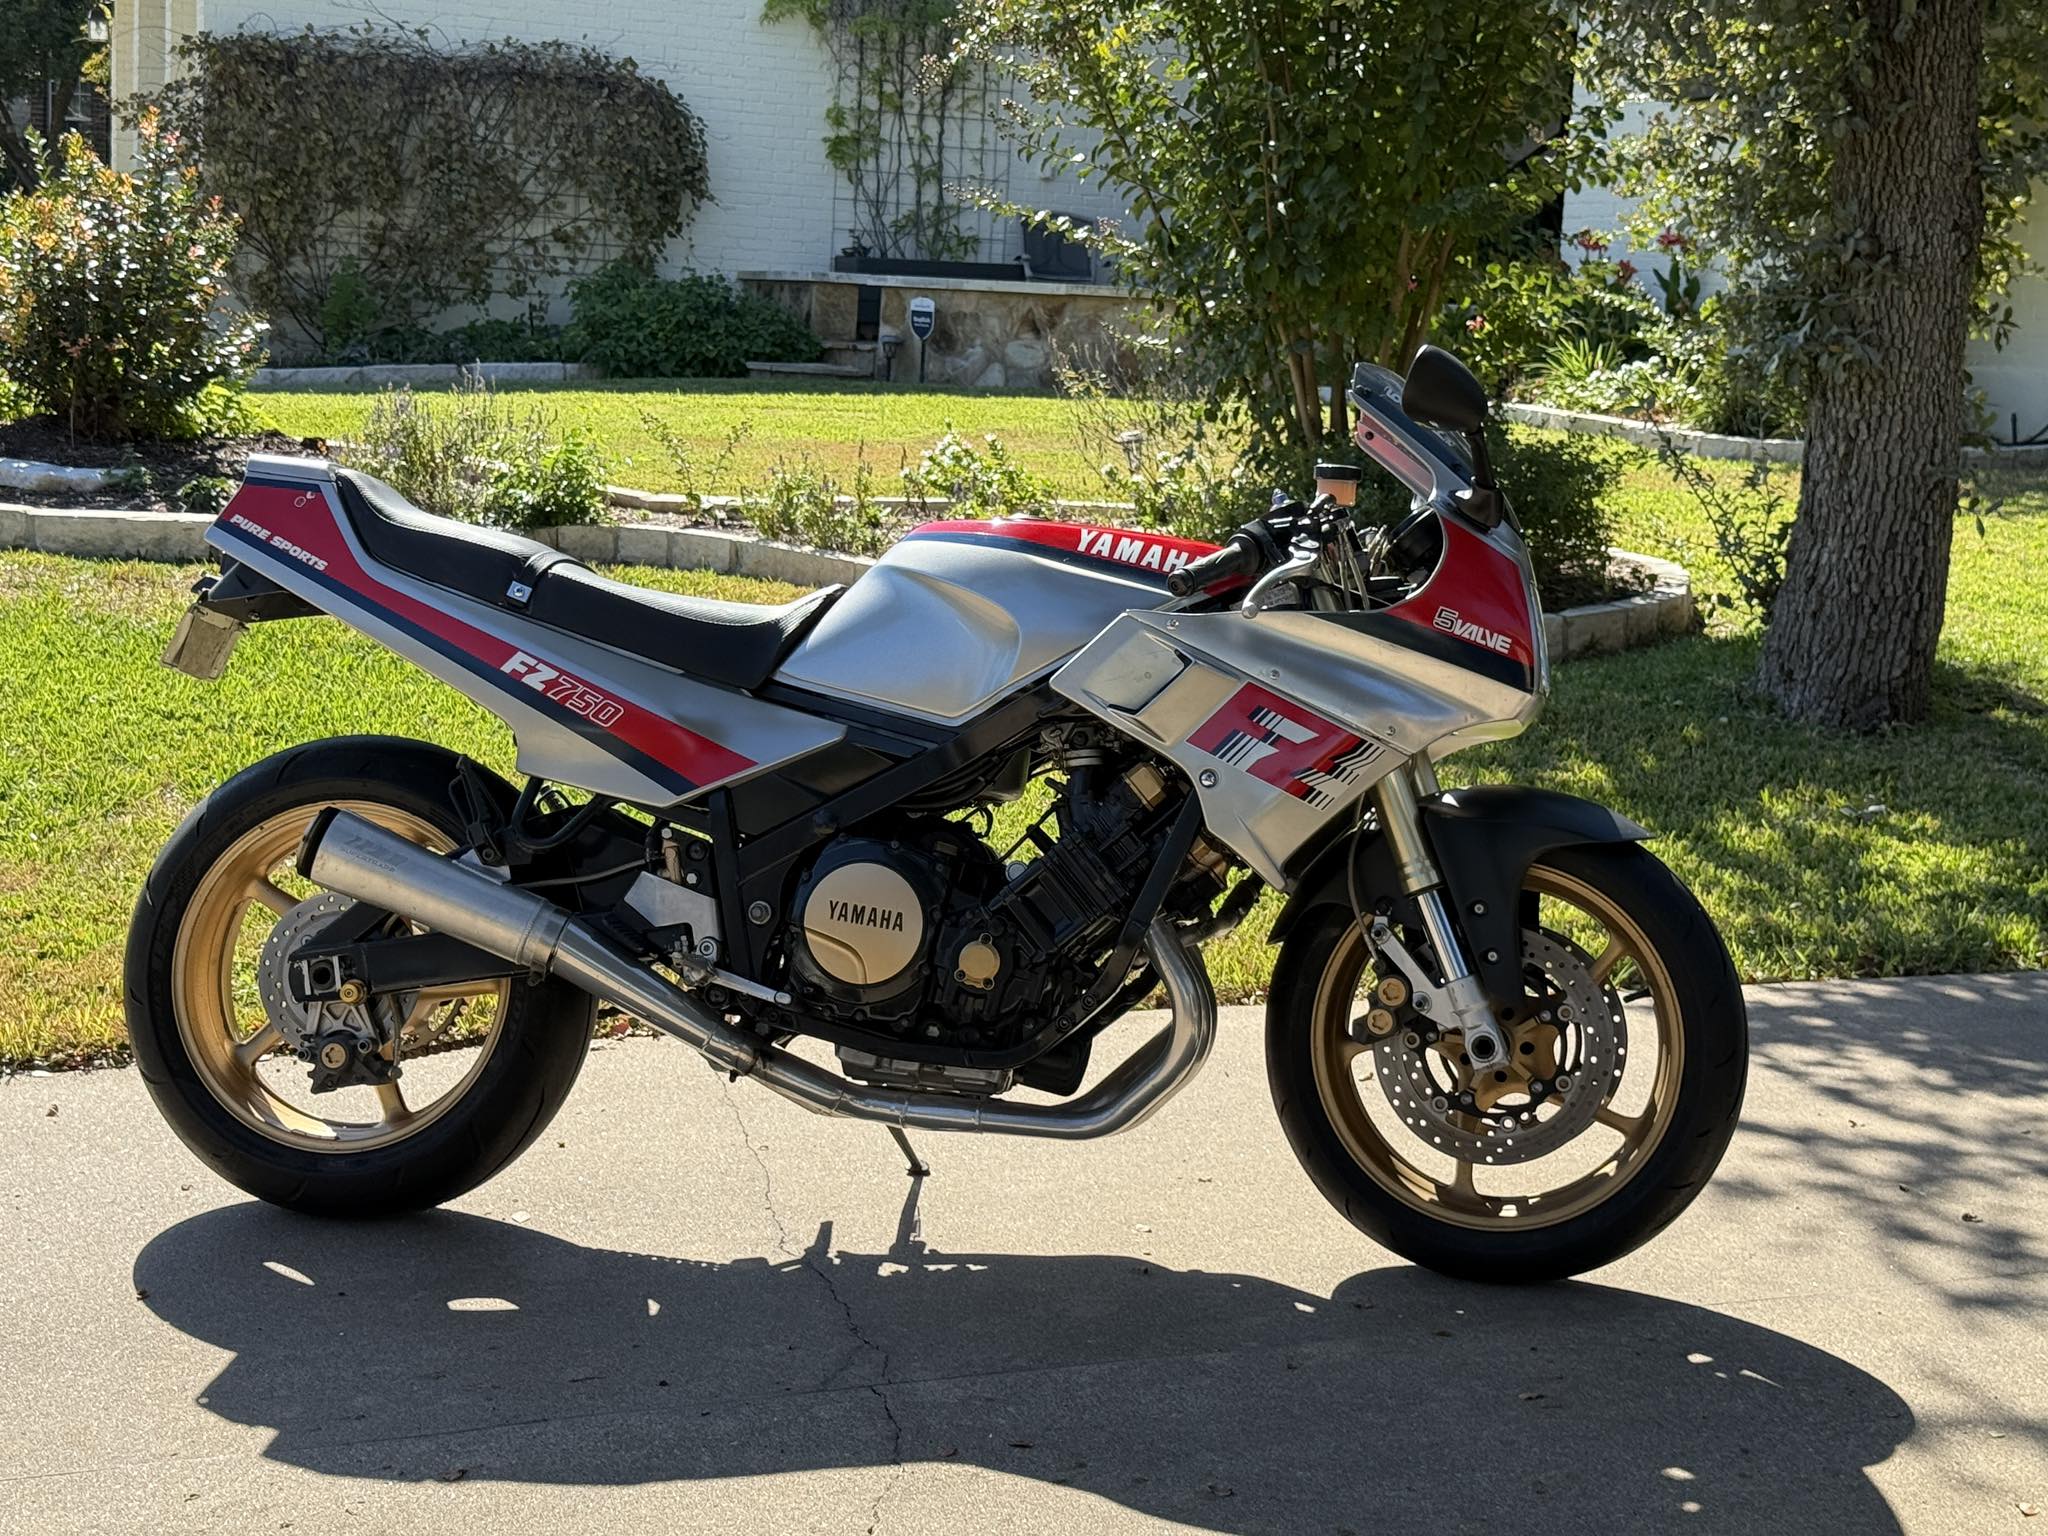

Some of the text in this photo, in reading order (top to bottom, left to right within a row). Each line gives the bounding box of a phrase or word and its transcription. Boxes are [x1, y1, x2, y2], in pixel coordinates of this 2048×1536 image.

[230, 513, 329, 571] PURE SPORTS
[1077, 528, 1204, 573] YAMAH
[829, 899, 904, 932] YAMAHA
